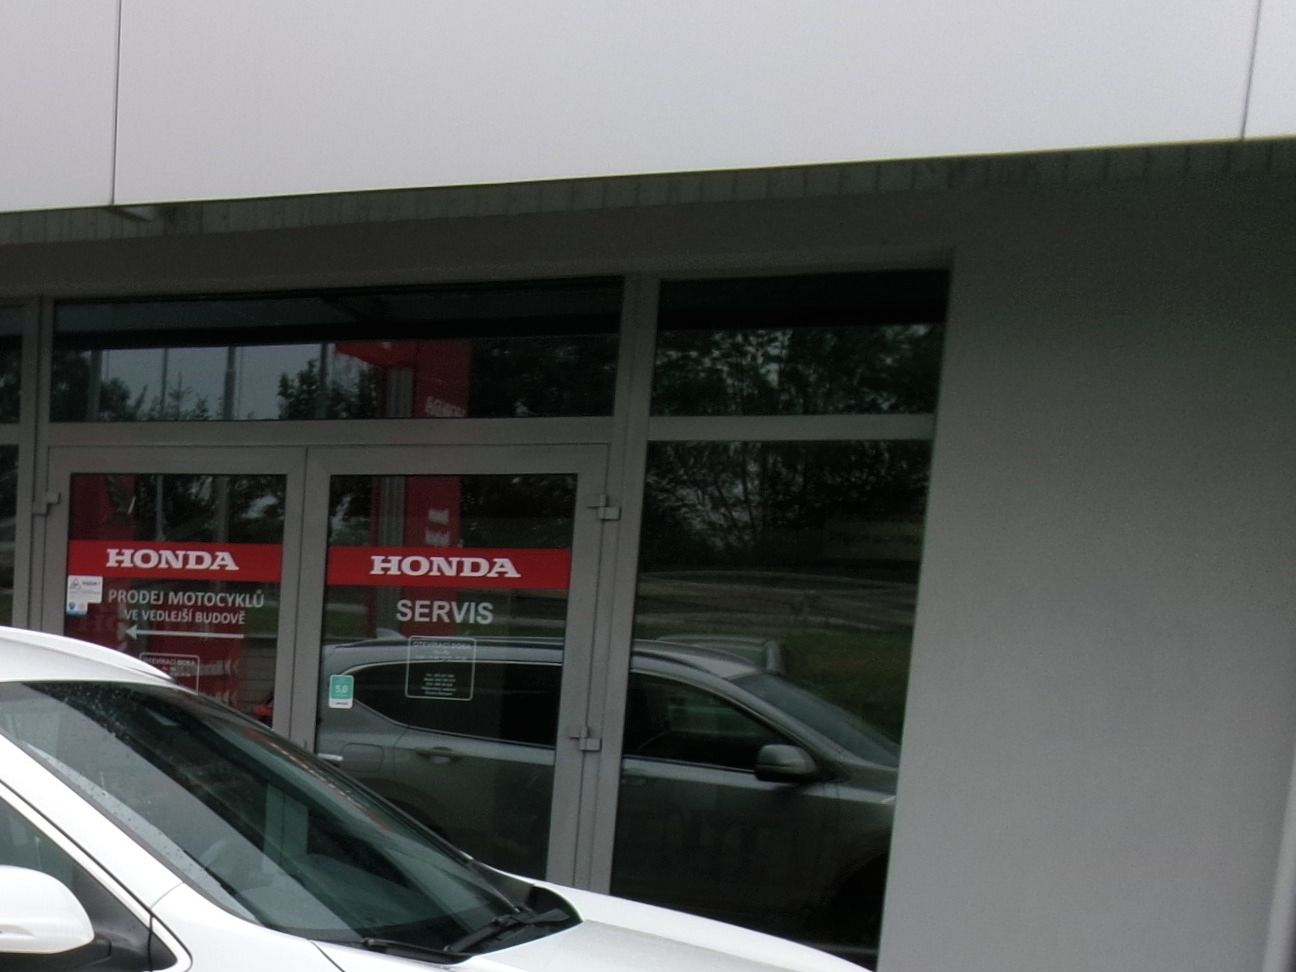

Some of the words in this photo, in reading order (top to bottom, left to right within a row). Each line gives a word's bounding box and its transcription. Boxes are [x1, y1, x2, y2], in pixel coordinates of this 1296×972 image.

[106, 548, 239, 571] HONDA
[370, 555, 521, 578] HONDA
[108, 589, 164, 605] PRODEJ
[168, 589, 264, 608] MOTOCYKLŮ
[124, 608, 138, 620] VE
[142, 608, 192, 622] VEDLEJŠÍ
[195, 610, 246, 625] BUDOVĚ
[396, 599, 494, 624] SERVIS
